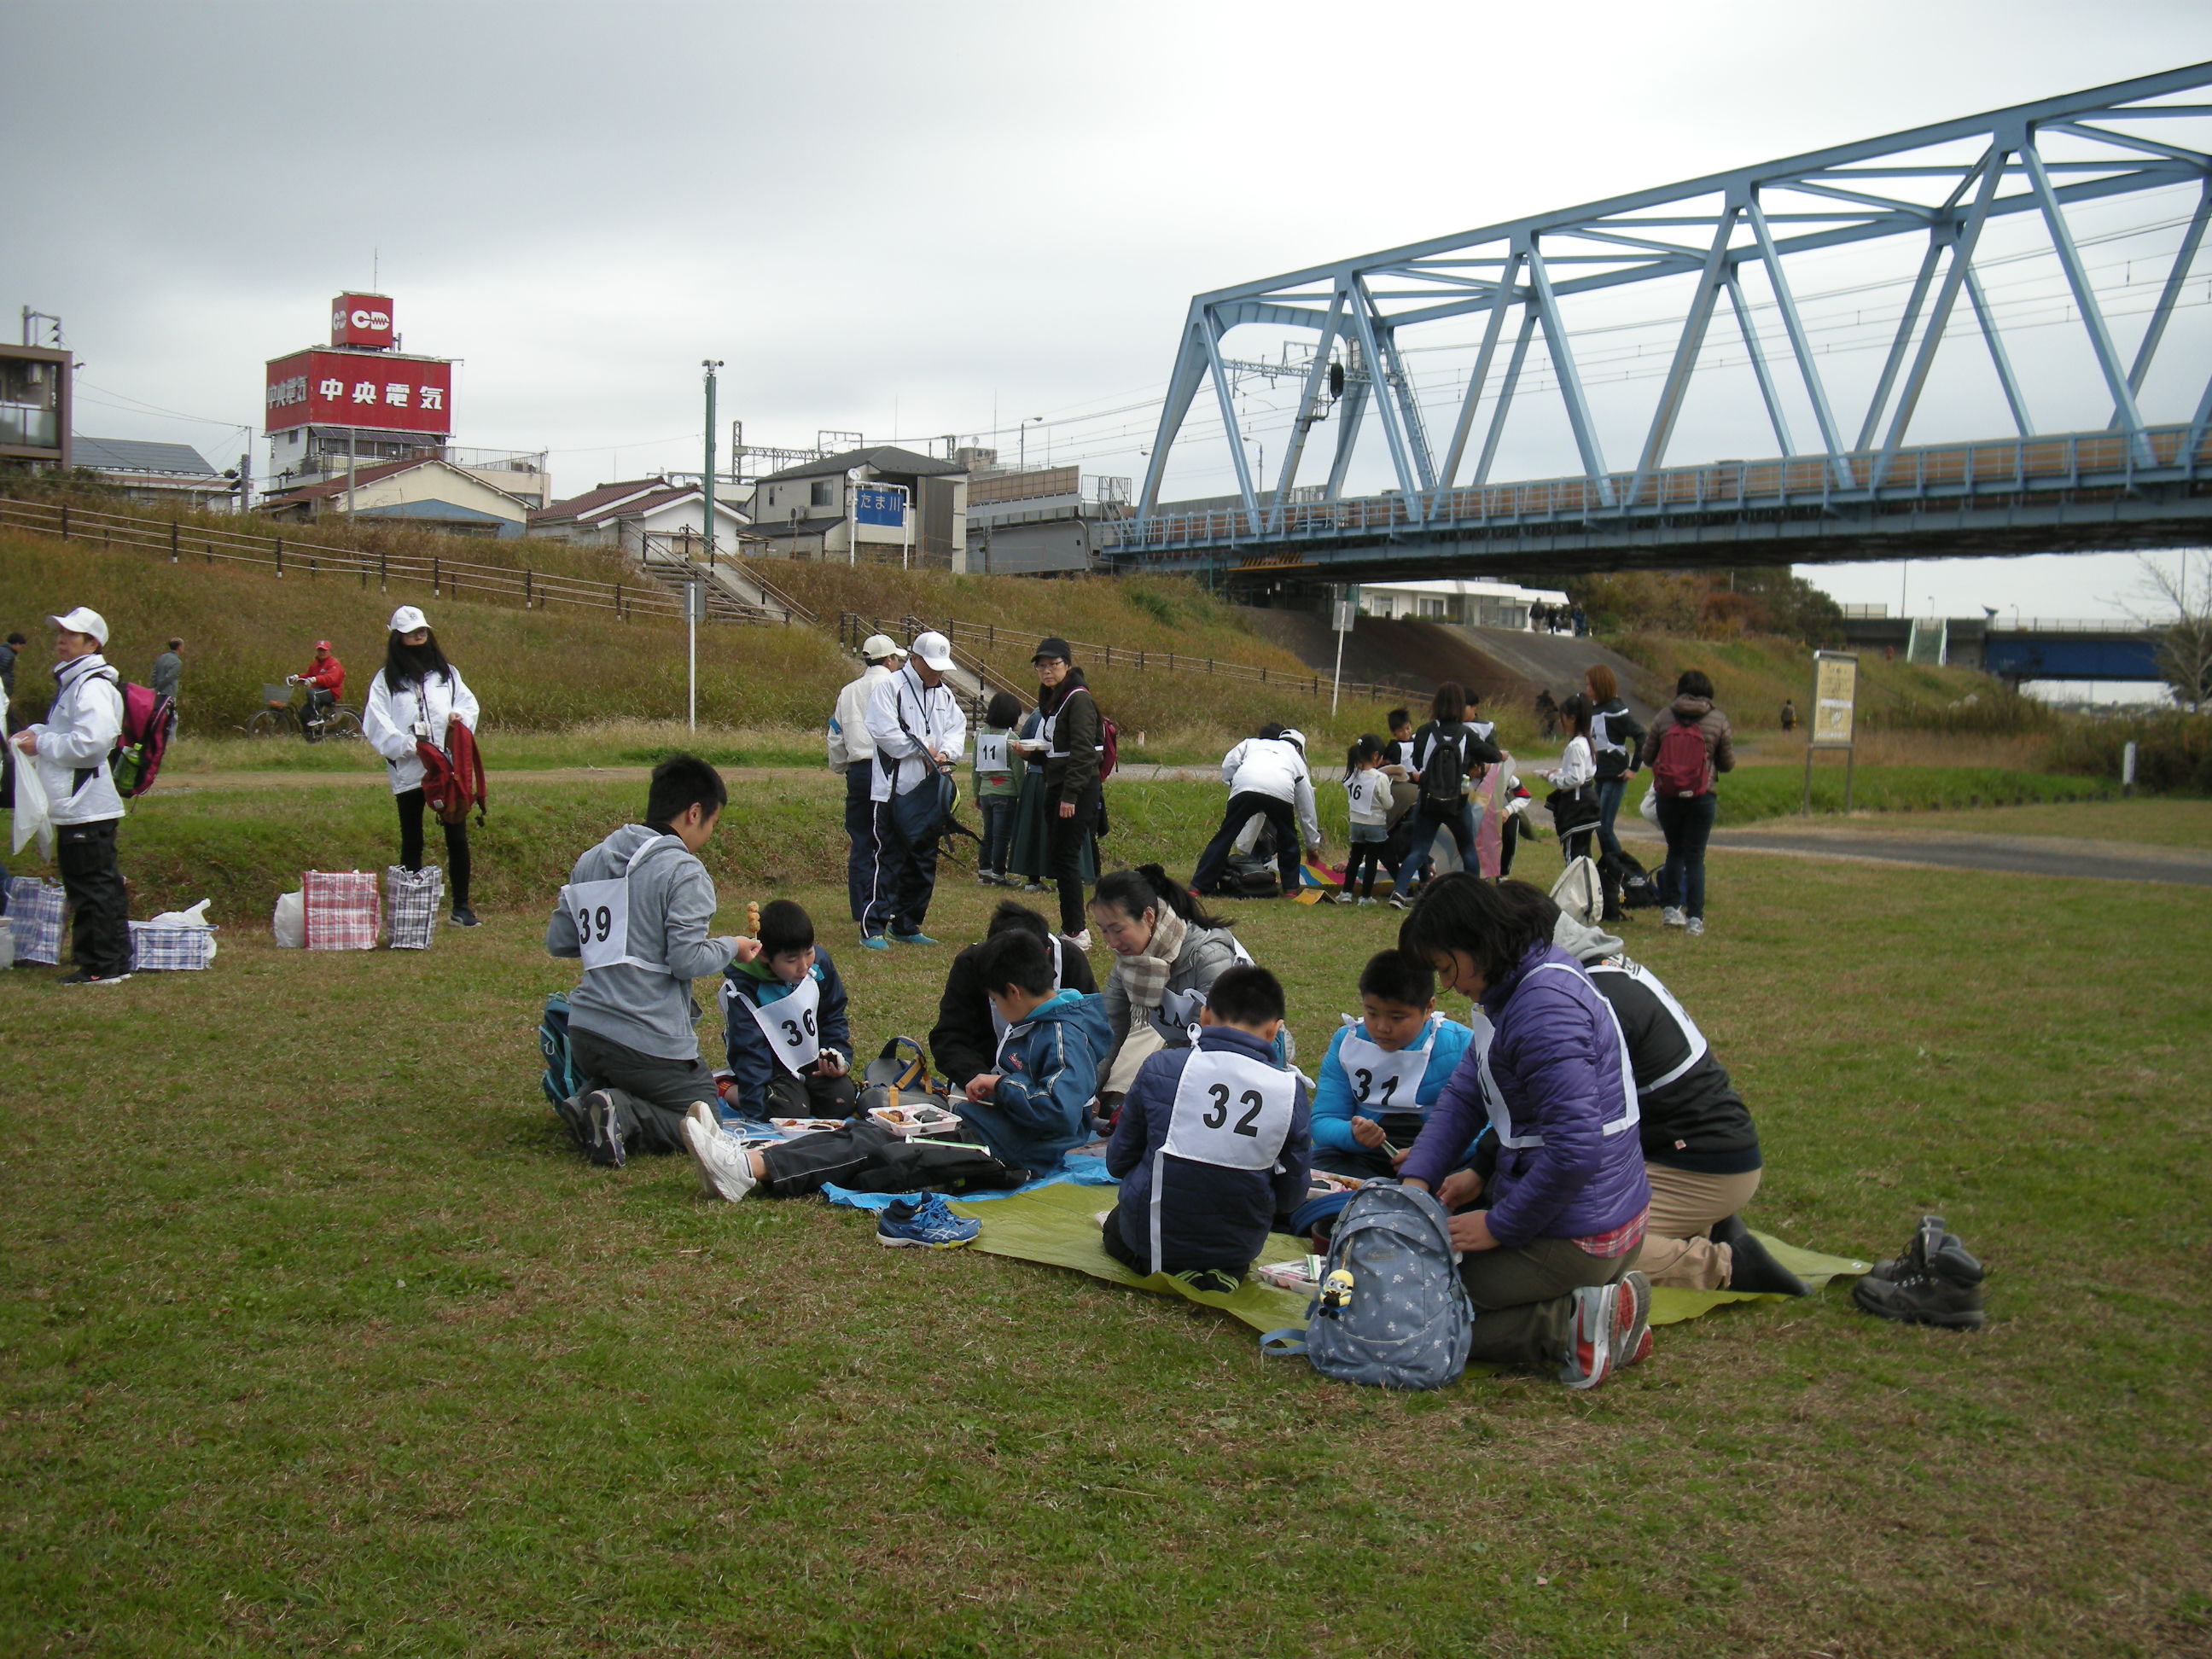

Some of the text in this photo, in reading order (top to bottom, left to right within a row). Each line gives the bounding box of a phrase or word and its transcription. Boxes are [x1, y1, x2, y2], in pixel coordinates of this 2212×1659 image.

[266, 375, 308, 410] 中央電気
[319, 378, 444, 410] 中央電気
[860, 493, 900, 512] たま川
[982, 744, 997, 760] 11
[1348, 783, 1363, 800] 16
[579, 905, 612, 945] 39
[781, 1008, 816, 1047] 36
[1353, 1068, 1400, 1106] 31
[1202, 1083, 1263, 1138] 32
